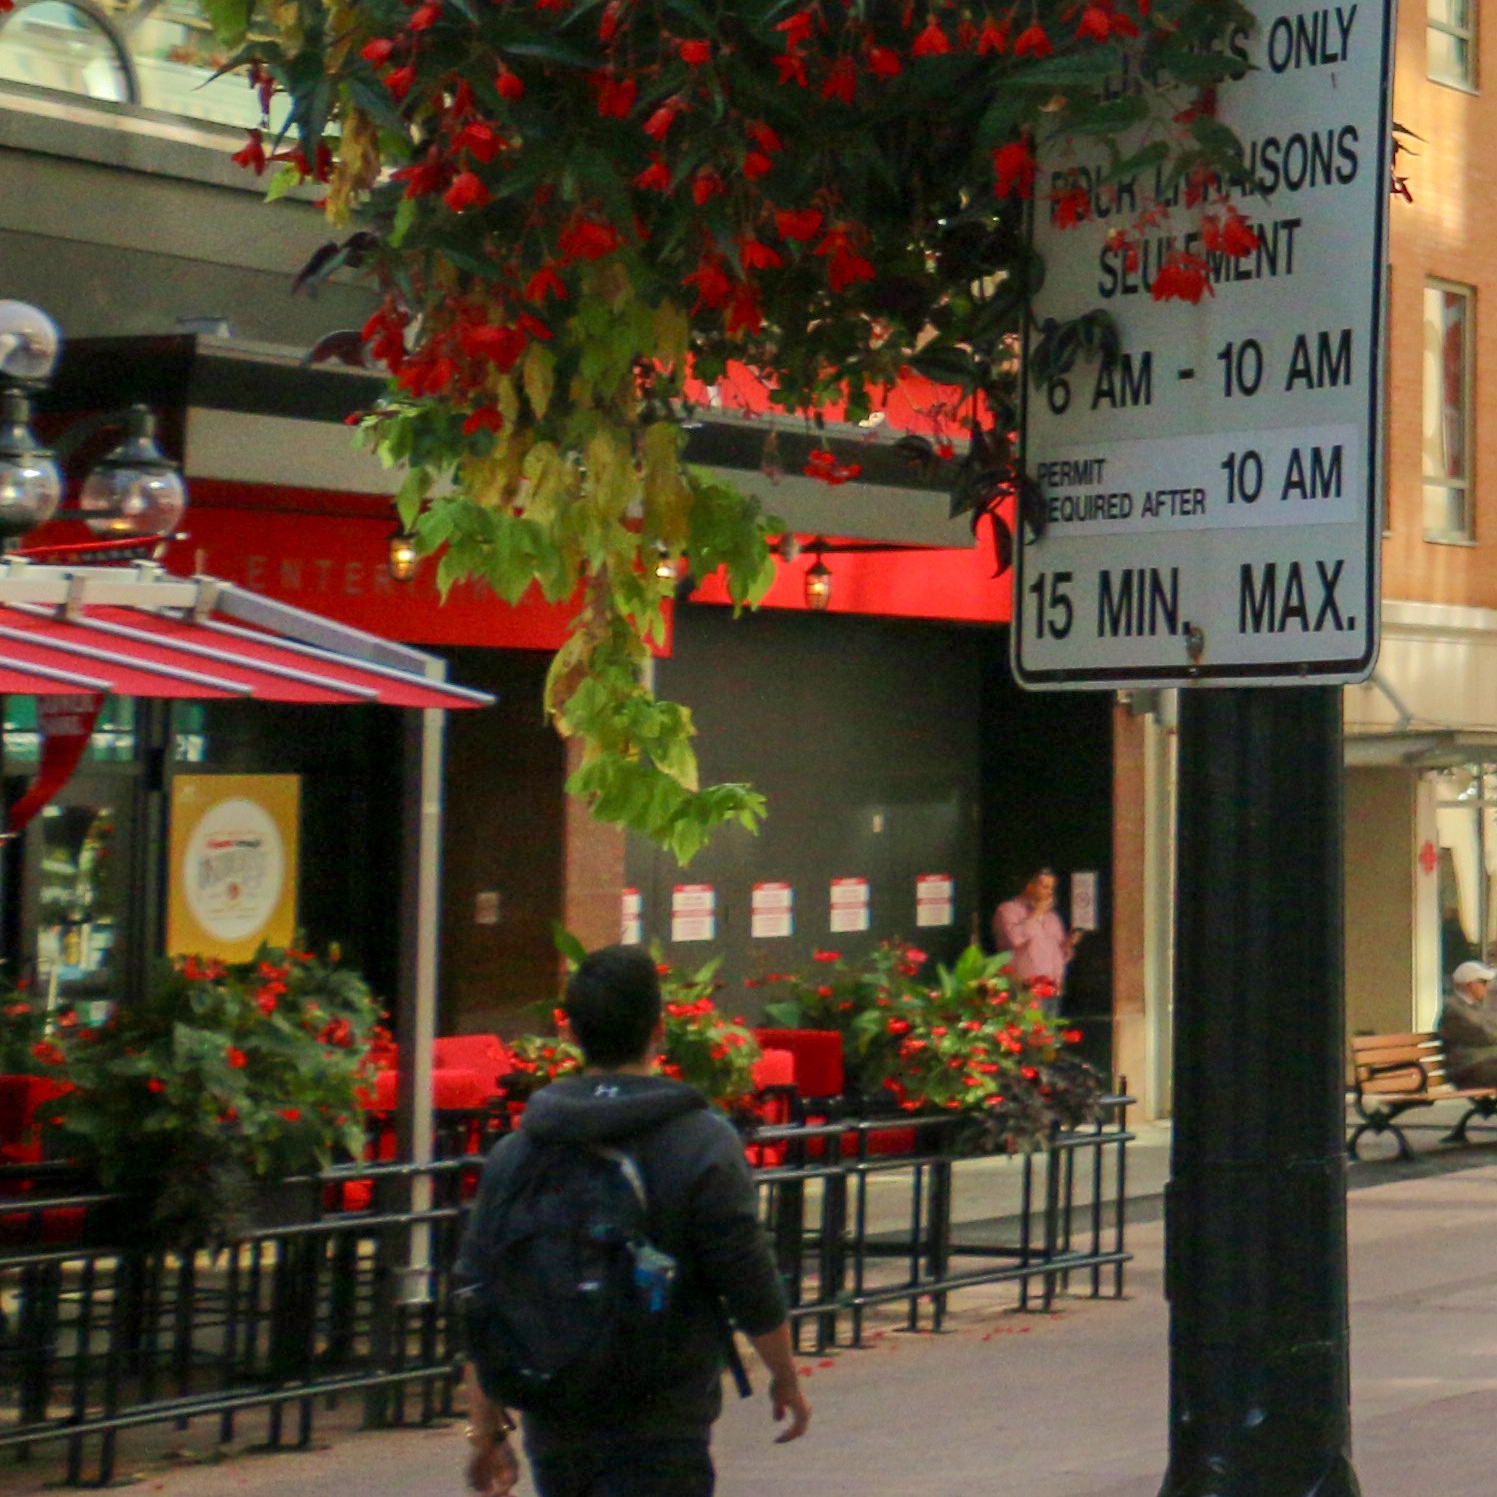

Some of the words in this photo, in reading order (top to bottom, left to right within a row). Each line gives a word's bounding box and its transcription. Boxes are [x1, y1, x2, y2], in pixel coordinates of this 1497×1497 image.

[1267, 4, 1358, 74] ONLY
[1091, 351, 1153, 410] AM
[1216, 338, 1263, 398] 10
[1284, 328, 1353, 392] AM
[1037, 458, 1107, 488] PERMIT
[1220, 450, 1263, 504] 10
[1280, 445, 1344, 501] AM
[1048, 491, 1134, 523] EQUIRED
[1141, 488, 1207, 518] AFTER
[1029, 571, 1074, 641] 15
[1097, 567, 1191, 638] MIN.
[1238, 559, 1357, 635] MAX.
